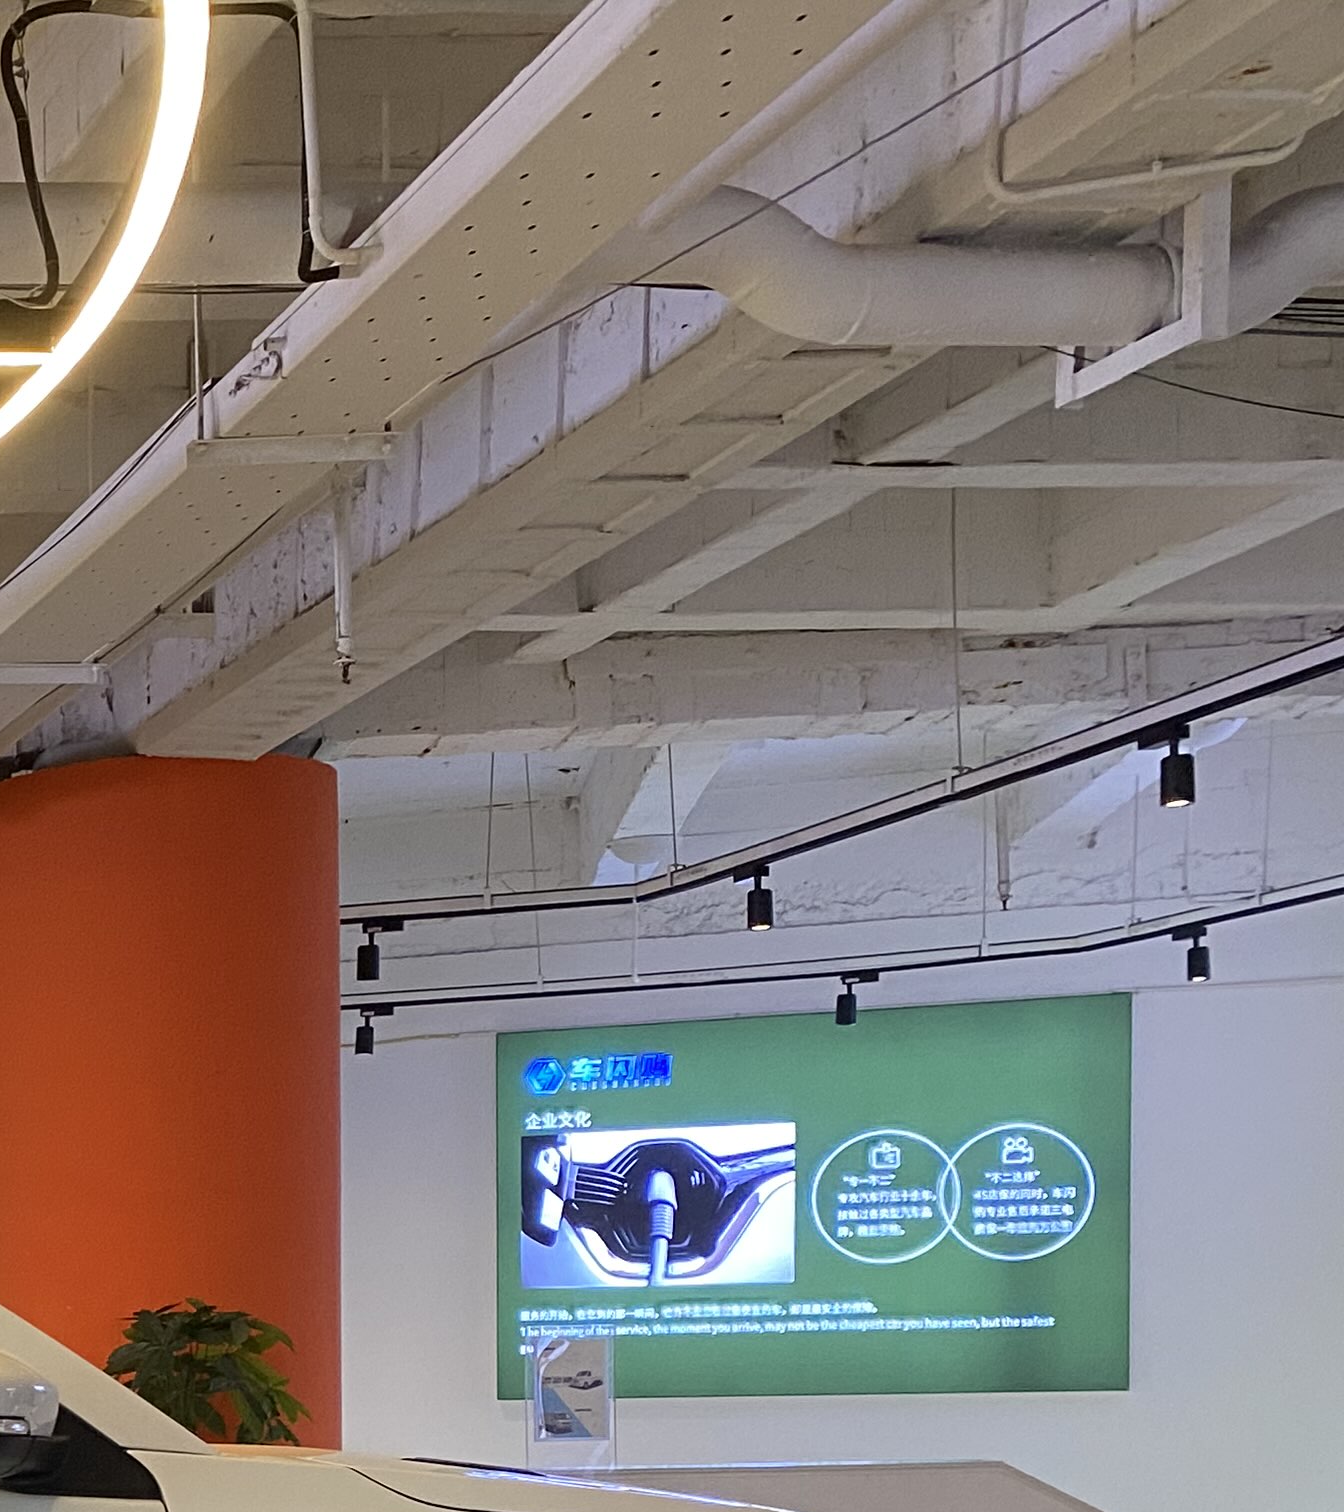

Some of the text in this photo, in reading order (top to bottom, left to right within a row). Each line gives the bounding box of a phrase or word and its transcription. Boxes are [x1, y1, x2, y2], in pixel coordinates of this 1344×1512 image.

[570, 1053, 673, 1082] 车闪购
[525, 1111, 592, 1130] 企业文化
[541, 1325, 584, 1339] beginning
[616, 1324, 652, 1337] service,
[653, 1323, 668, 1335] the
[712, 1323, 731, 1336] you
[732, 1320, 764, 1334] arrive,
[765, 1322, 787, 1334] may
[788, 1320, 805, 1332] not
[806, 1320, 820, 1332] be
[821, 1319, 838, 1331] the
[839, 1318, 885, 1332] cheapest
[925, 1317, 950, 1329] have
[952, 1319, 980, 1330] seen,
[981, 1316, 1000, 1328] but
[1002, 1316, 1020, 1328] the
[1022, 1315, 1056, 1328] safest
